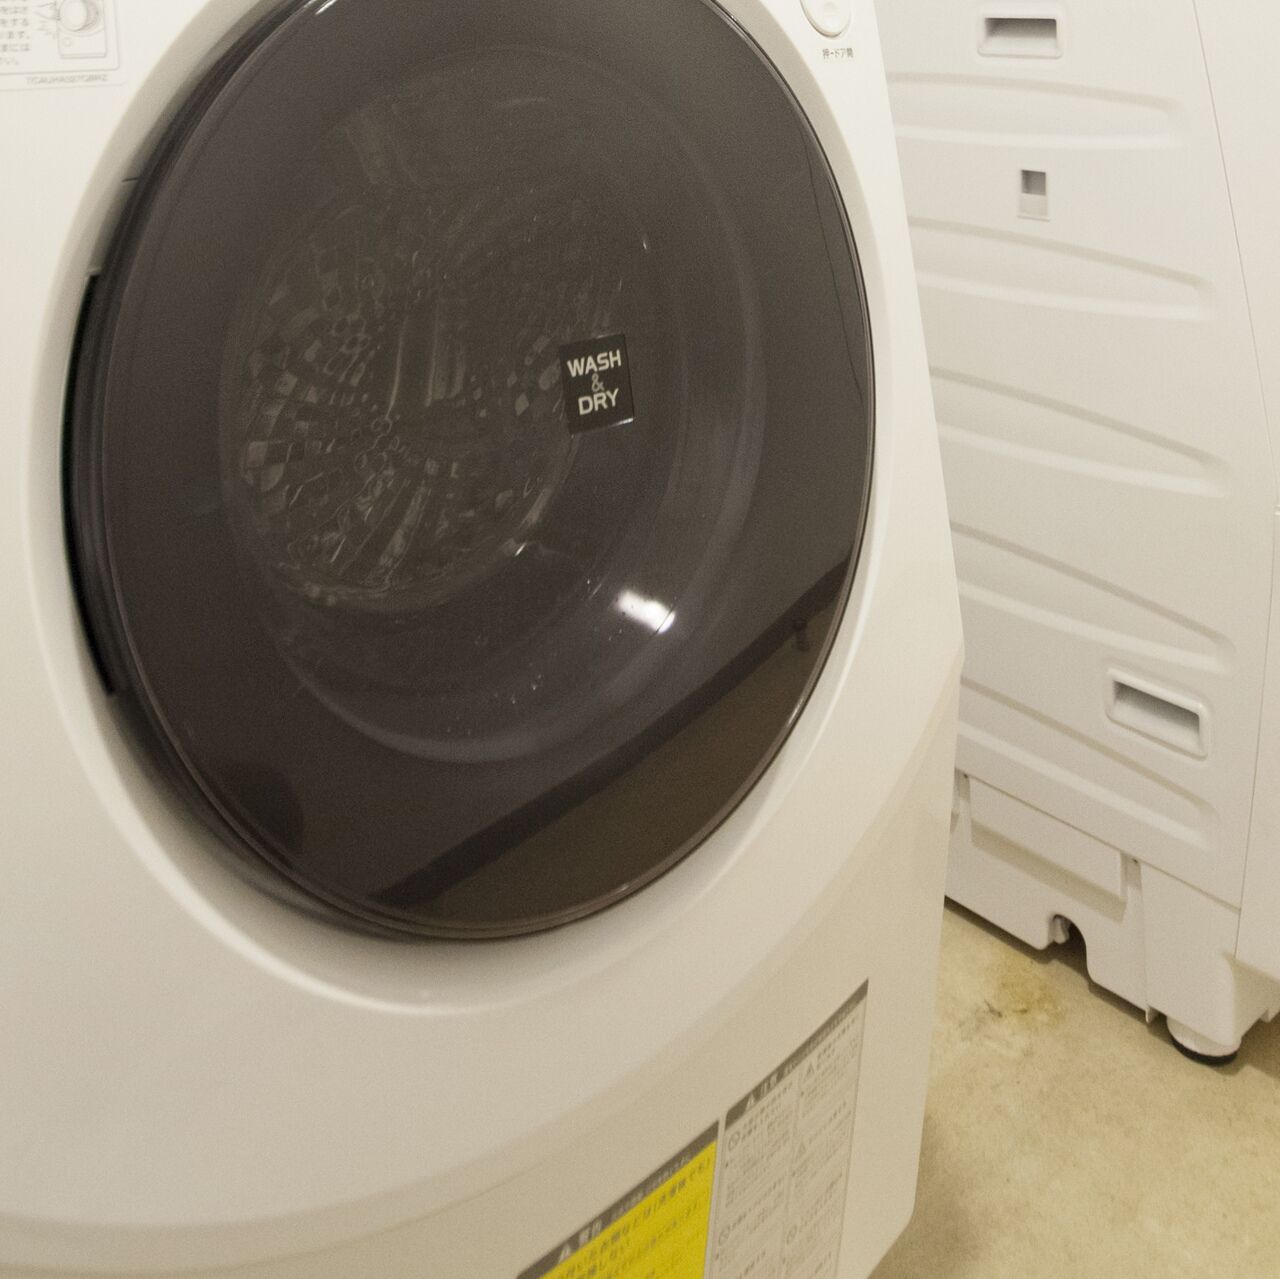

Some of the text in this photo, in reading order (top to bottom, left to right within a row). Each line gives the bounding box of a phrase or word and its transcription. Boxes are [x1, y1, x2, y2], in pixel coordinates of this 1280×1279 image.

[566, 349, 622, 378] WASH
[591, 373, 604, 392] &
[578, 388, 619, 415] DRY
